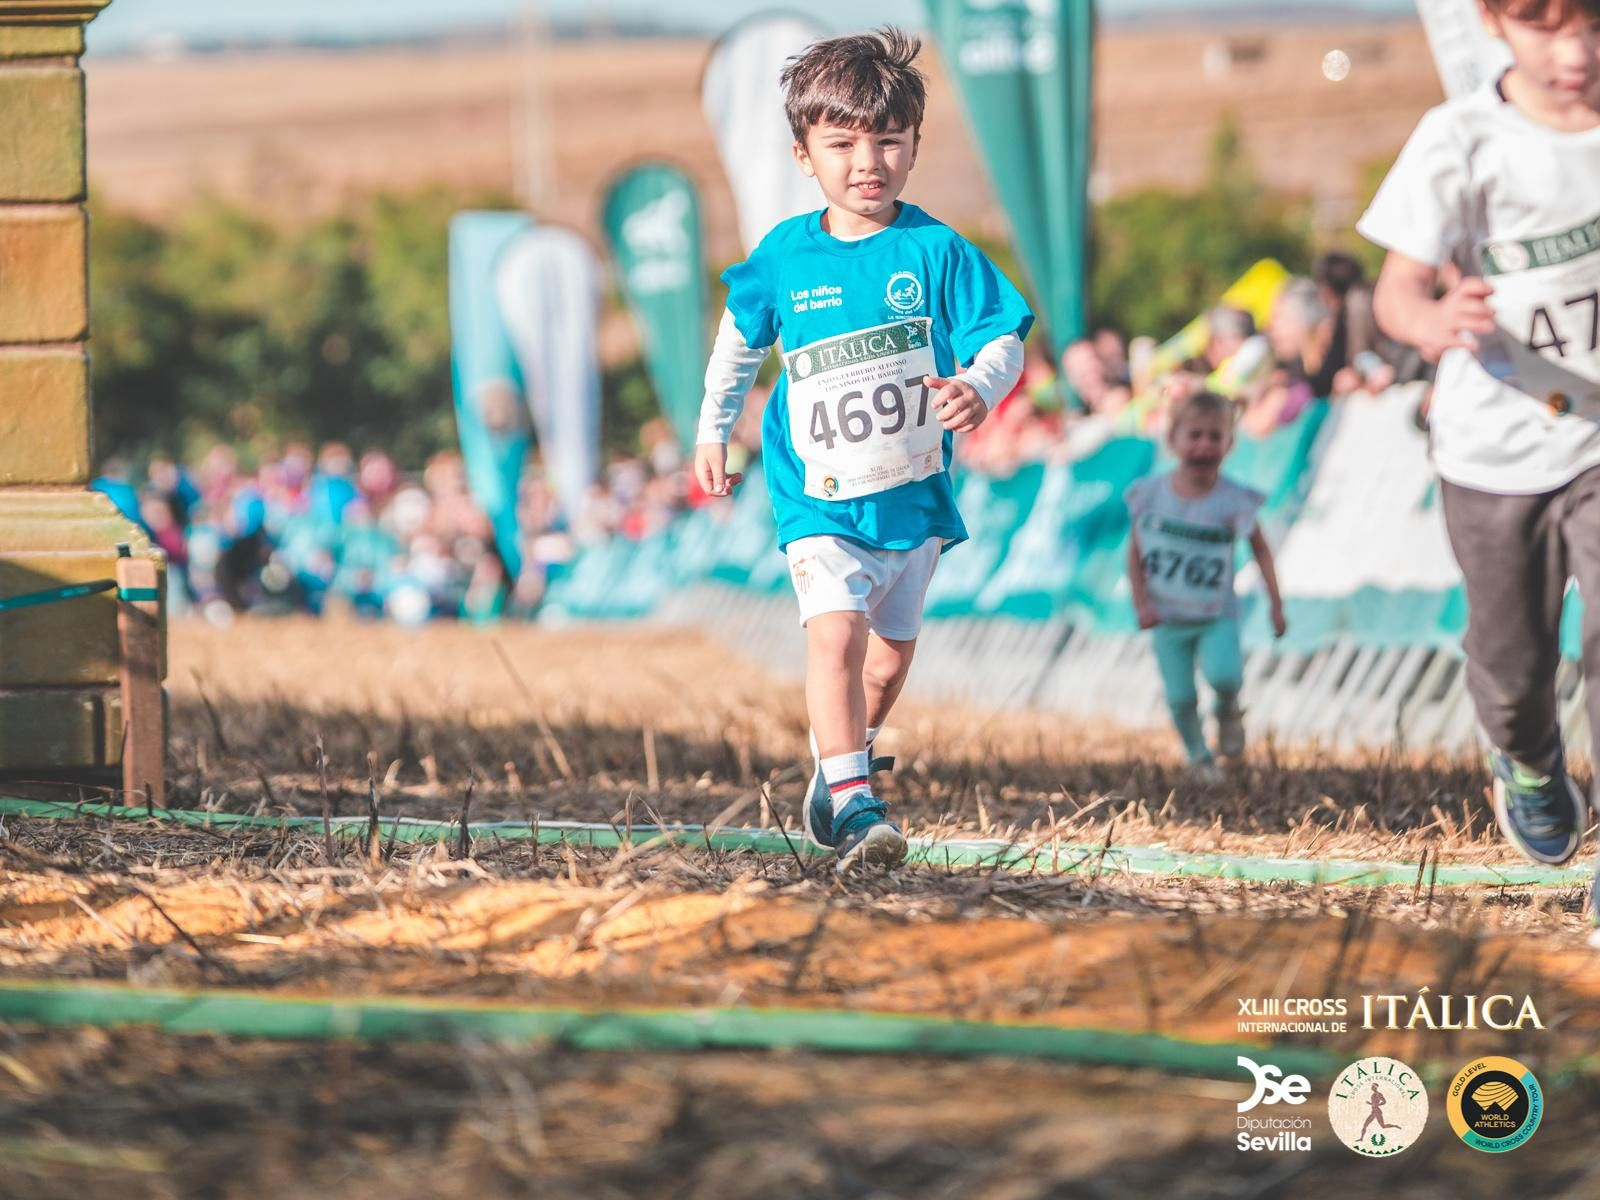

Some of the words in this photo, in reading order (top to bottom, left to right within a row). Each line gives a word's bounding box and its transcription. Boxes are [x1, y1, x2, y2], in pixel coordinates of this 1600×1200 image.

[790, 289, 809, 301] Los
[811, 284, 842, 297] niños
[793, 300, 808, 313] del
[810, 296, 842, 310] barrio
[818, 332, 897, 367] ITÁLICA
[809, 374, 930, 450] 4697
